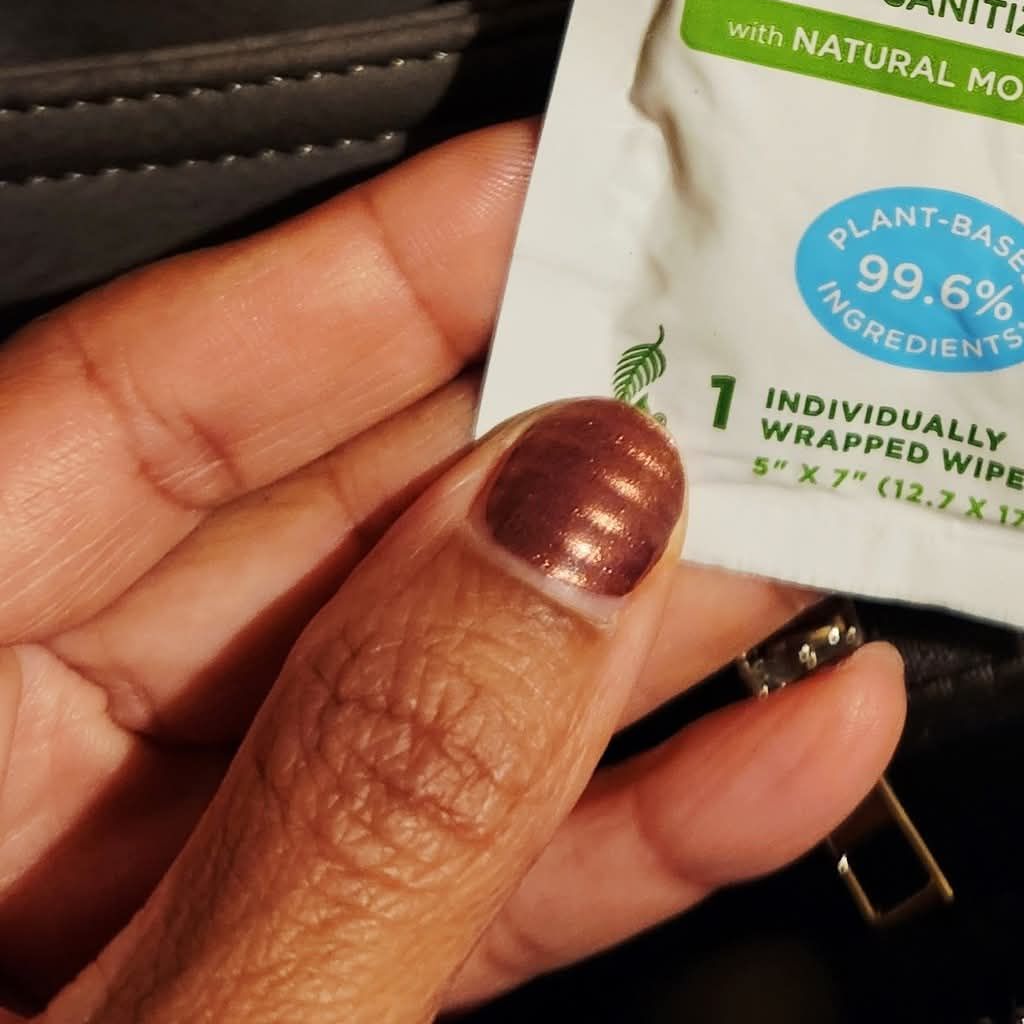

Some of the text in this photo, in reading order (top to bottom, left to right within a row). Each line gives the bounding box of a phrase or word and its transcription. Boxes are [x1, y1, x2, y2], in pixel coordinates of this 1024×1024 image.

[727, 19, 784, 48] with
[791, 26, 956, 88] NATURAL
[856, 253, 1014, 321] 99.6%
[710, 374, 737, 431] 1
[765, 387, 1008, 452] INDIVIDUALLY
[760, 417, 930, 465] WRAPPED
[798, 463, 822, 486] X
[877, 475, 957, 511] (12.7
[964, 495, 988, 521] X
